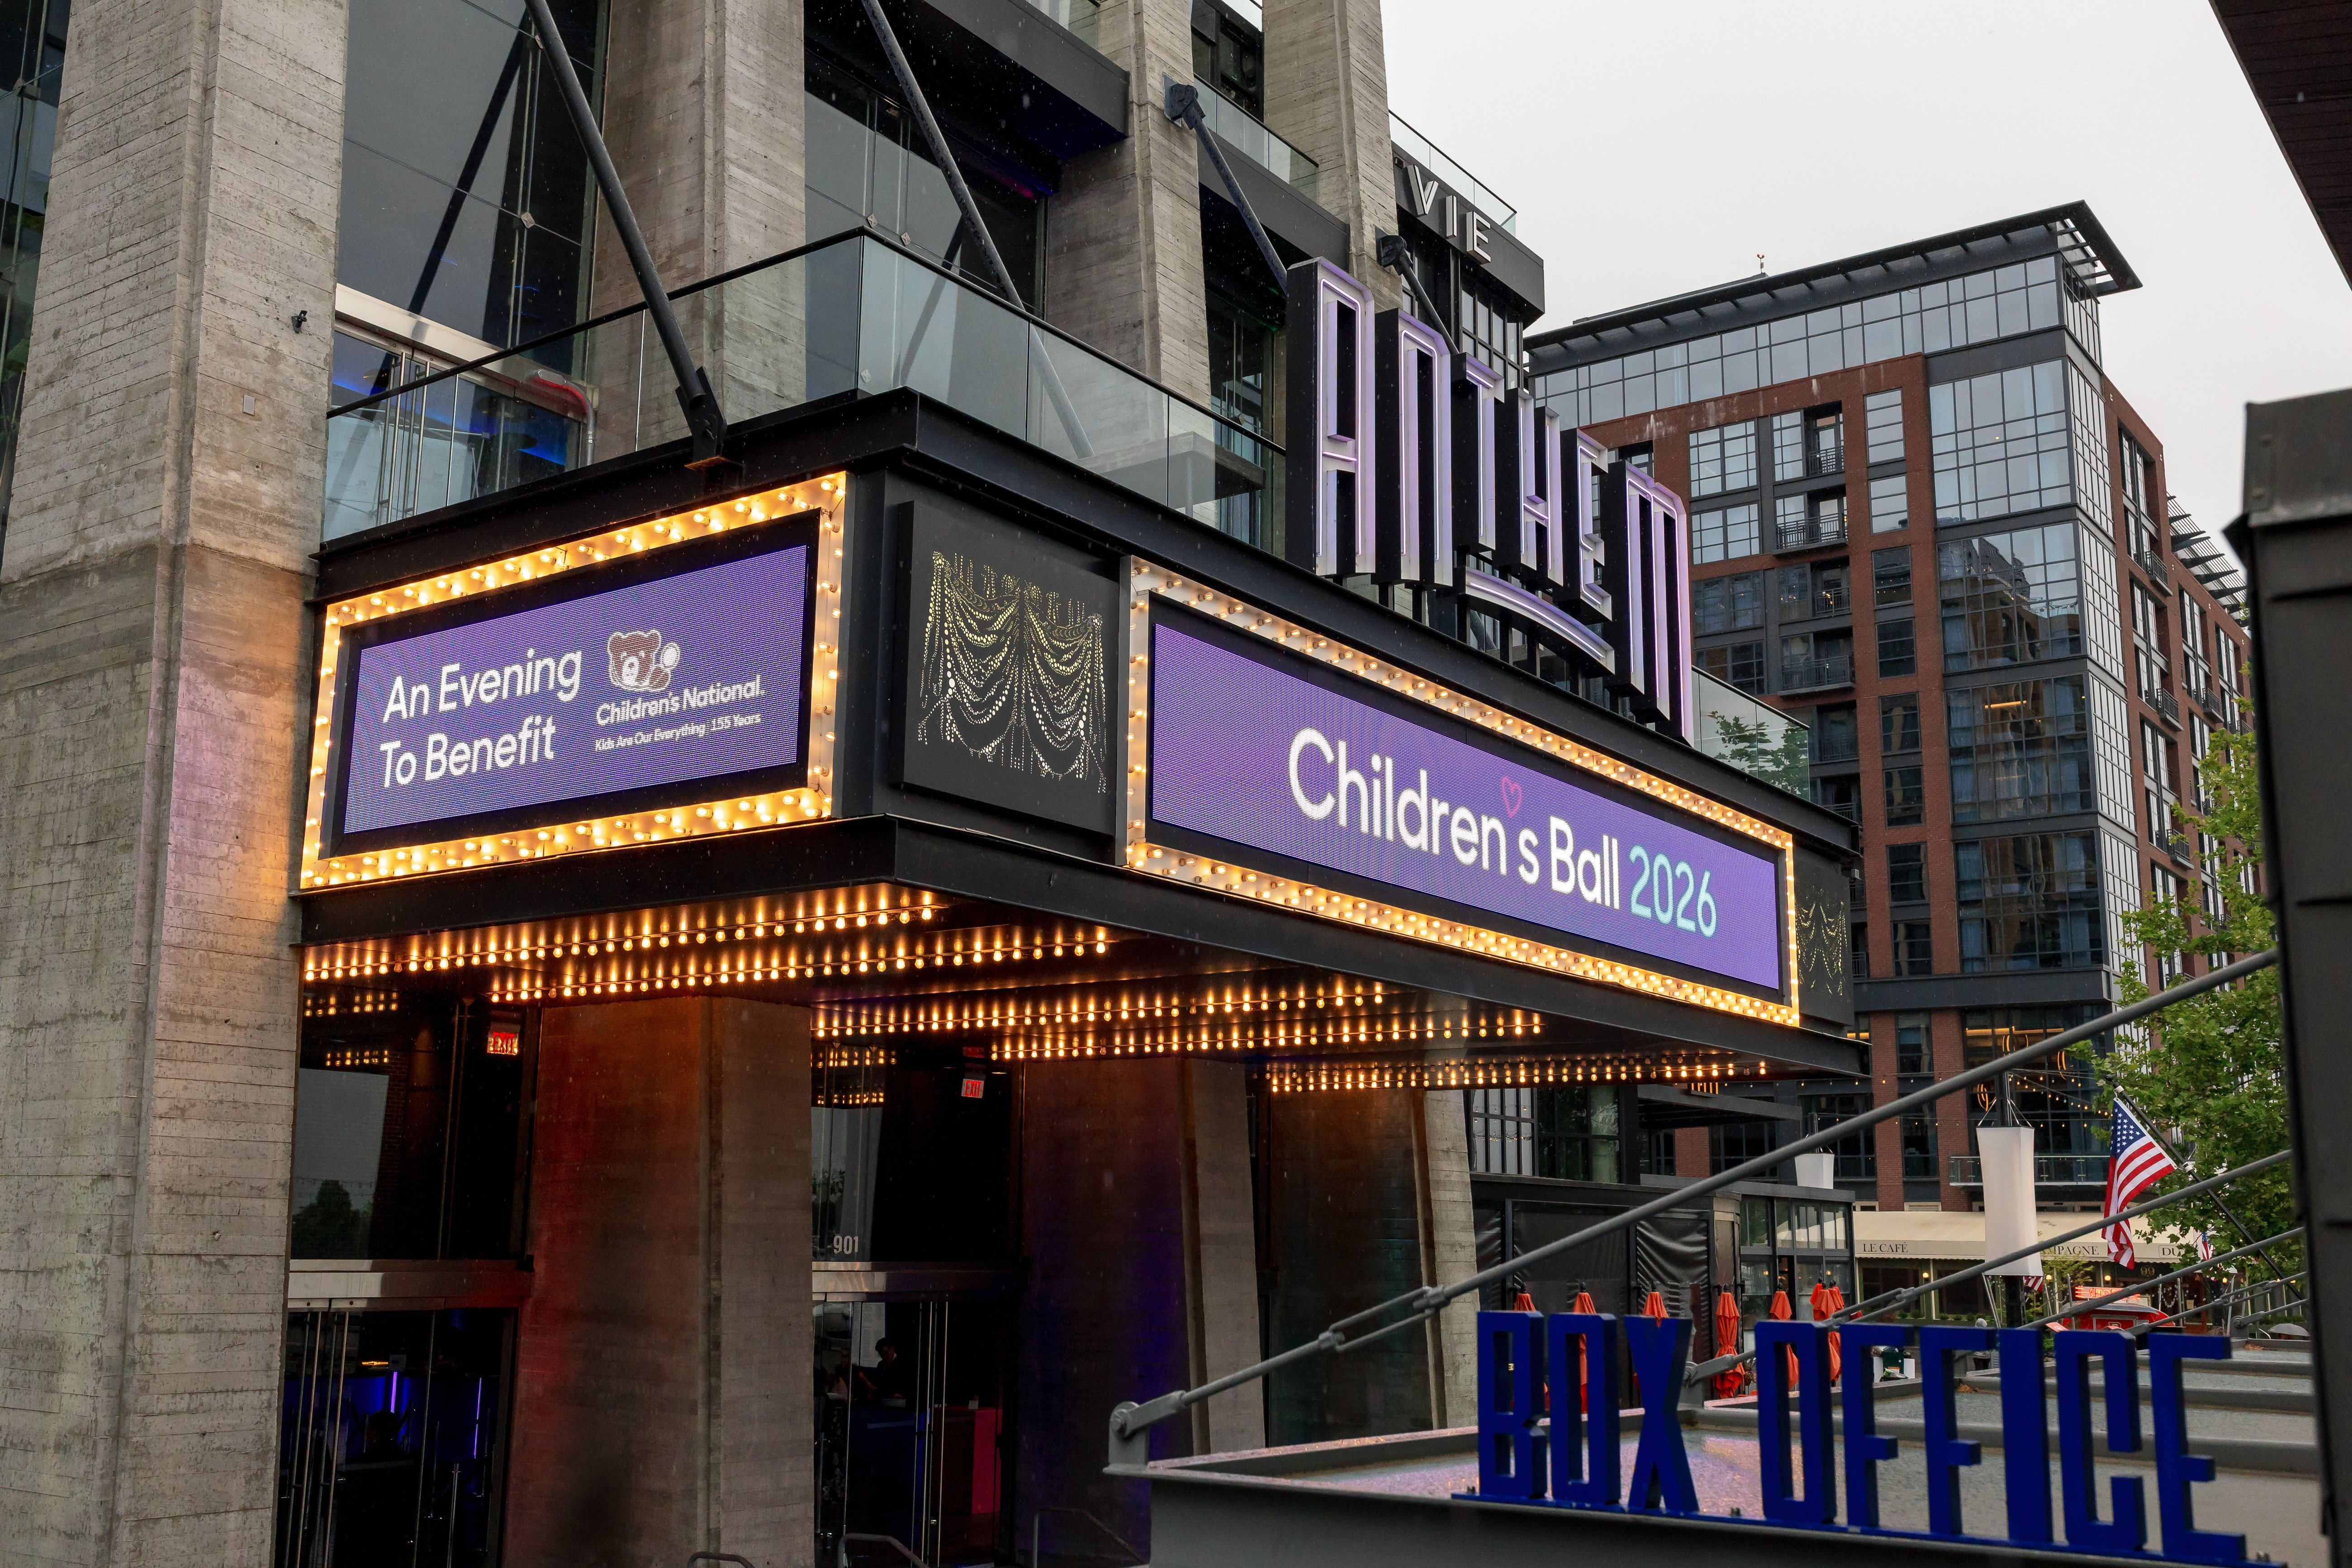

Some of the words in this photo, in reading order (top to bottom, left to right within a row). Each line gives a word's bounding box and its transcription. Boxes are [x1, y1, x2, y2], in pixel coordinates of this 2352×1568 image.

[1407, 165, 1491, 265] VIE
[1285, 257, 1693, 748] ANTHEM
[383, 675, 430, 723] An
[438, 647, 583, 712] Evening
[596, 691, 680, 726] Children's
[379, 740, 417, 788] To
[424, 714, 557, 781] Benefit
[595, 737, 615, 752] Kids
[616, 735, 633, 748] Are
[634, 731, 653, 745] Our
[654, 723, 707, 742] Everything
[711, 717, 731, 732] 155
[733, 713, 762, 726] Years
[1549, 814, 1620, 911] Ball
[1628, 843, 1717, 938] 2026
[493, 1032, 516, 1054] EXIT
[964, 1079, 982, 1098] EXIT
[833, 1235, 858, 1254] 901
[1863, 1243, 1877, 1252] LE
[1879, 1242, 1908, 1253] CAFÉ
[2140, 1267, 2155, 1275] 99
[1476, 1310, 1699, 1514] BOX
[1755, 1320, 2247, 1562] OFFICE
